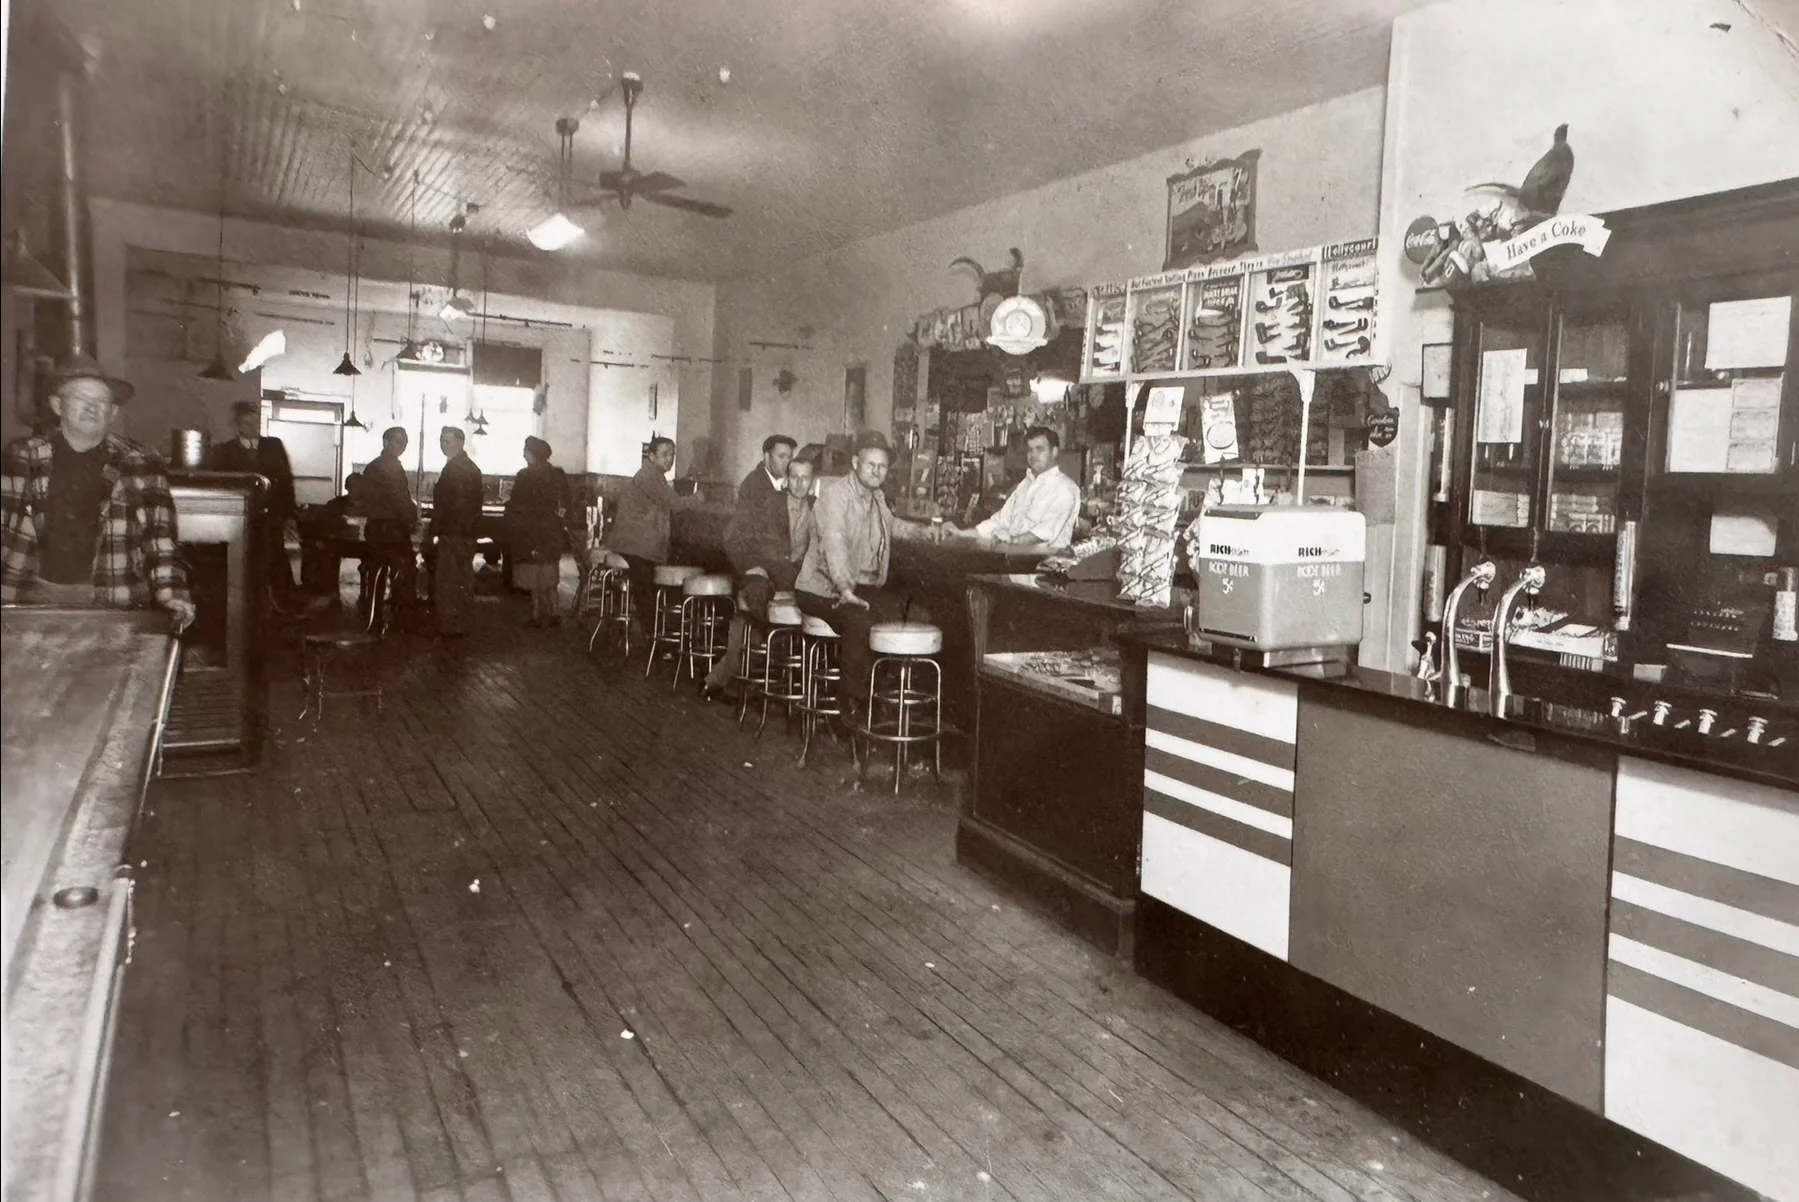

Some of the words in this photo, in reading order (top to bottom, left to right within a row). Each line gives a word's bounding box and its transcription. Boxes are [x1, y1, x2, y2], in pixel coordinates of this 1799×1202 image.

[1506, 236, 1537, 260] Have
[1540, 231, 1548, 243] a
[1551, 220, 1587, 238] Coke
